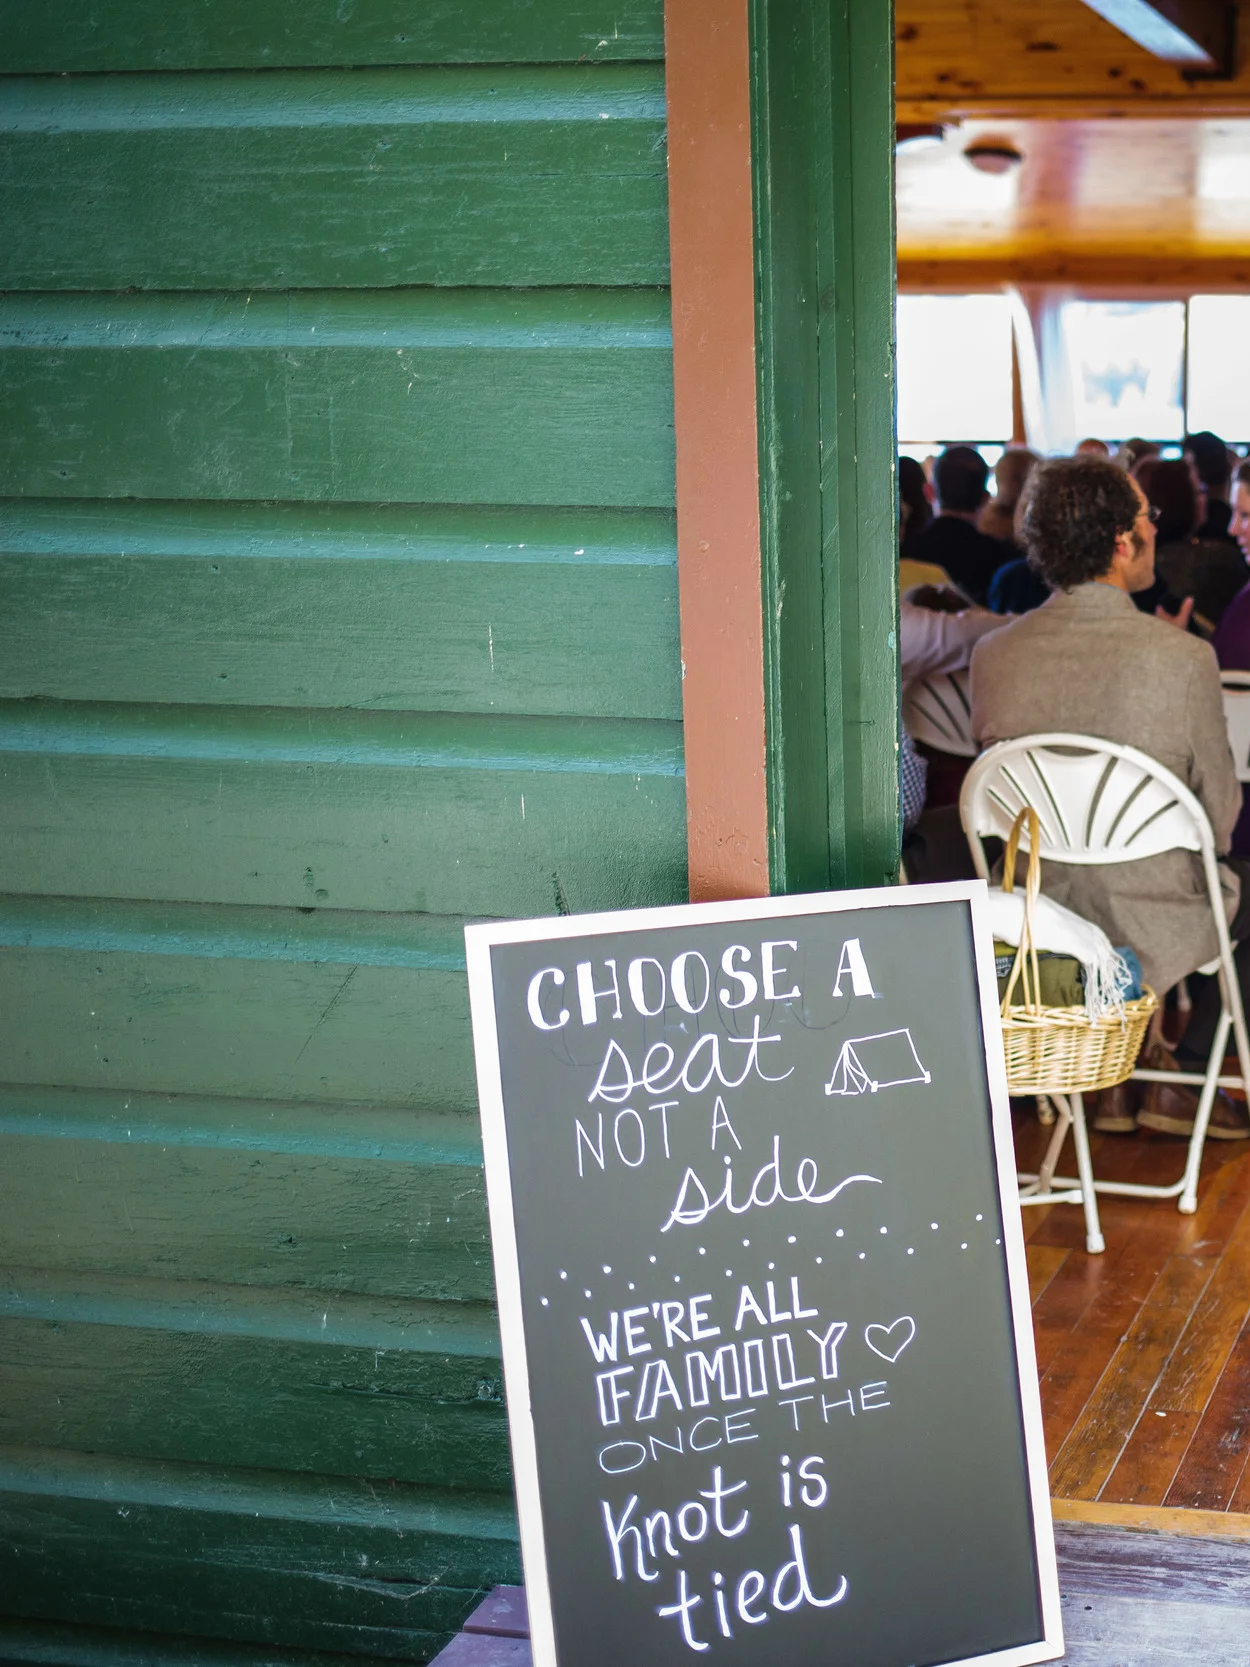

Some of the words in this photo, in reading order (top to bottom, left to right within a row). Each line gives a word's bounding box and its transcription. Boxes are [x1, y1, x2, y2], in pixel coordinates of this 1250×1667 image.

[527, 939, 801, 1031] CHOOSE
[832, 937, 876, 999] A
[587, 1014, 796, 1103] seat
[575, 1101, 681, 1178] NOT
[711, 1095, 742, 1151] A
[660, 1135, 883, 1233] side
[580, 1293, 722, 1362] WE'RE
[735, 1276, 819, 1331] ALL
[596, 1322, 848, 1427] FAMILY
[599, 1408, 760, 1474] ONCE
[778, 1381, 892, 1432] THE
[780, 1454, 829, 1509] is
[658, 1523, 848, 1652] tied
